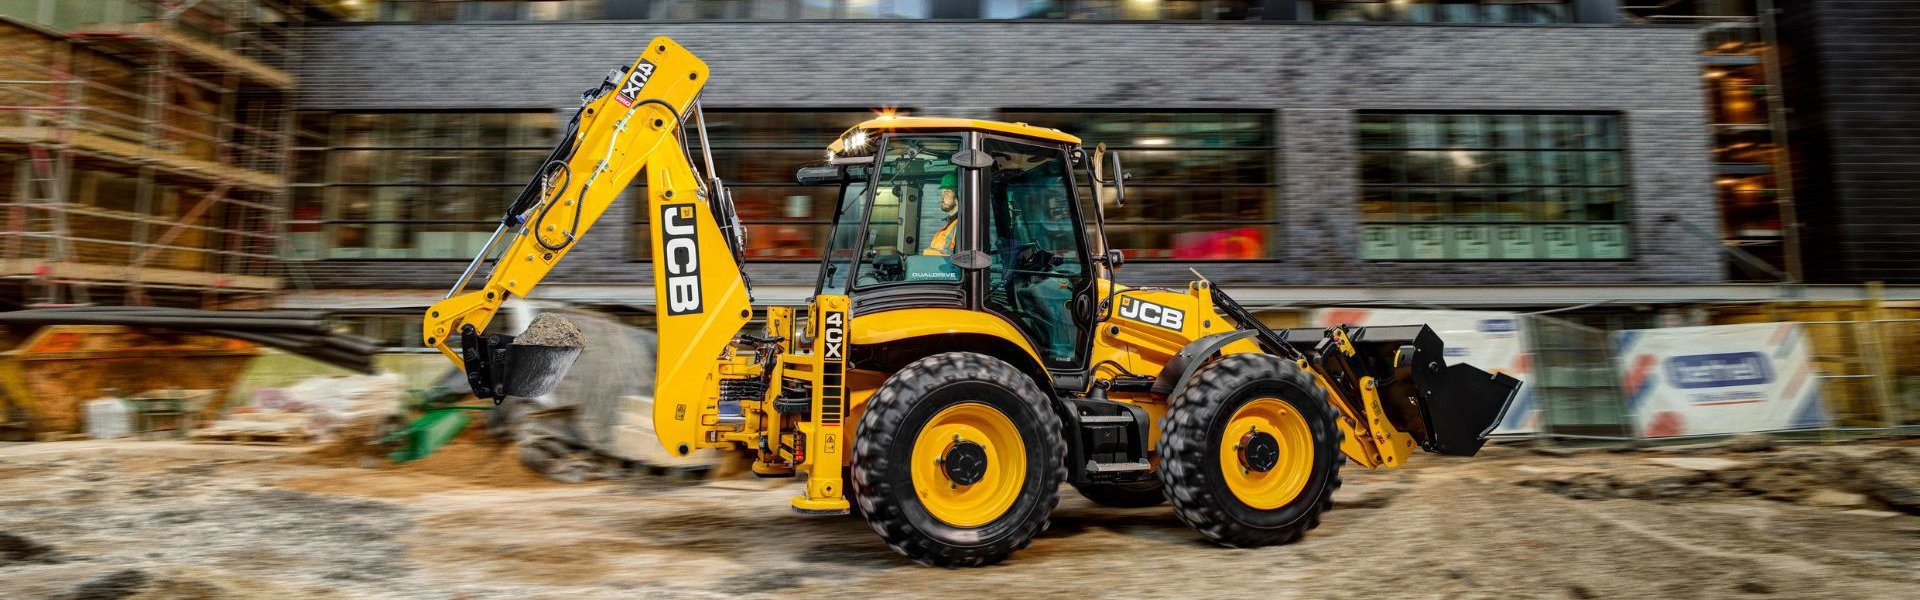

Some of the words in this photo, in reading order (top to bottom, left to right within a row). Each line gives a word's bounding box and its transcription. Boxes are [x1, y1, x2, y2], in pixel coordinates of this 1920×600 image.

[621, 63, 654, 99] 4CX
[664, 207, 699, 313] JCB
[825, 312, 843, 358] 4CX
[1120, 299, 1183, 330] JCB
